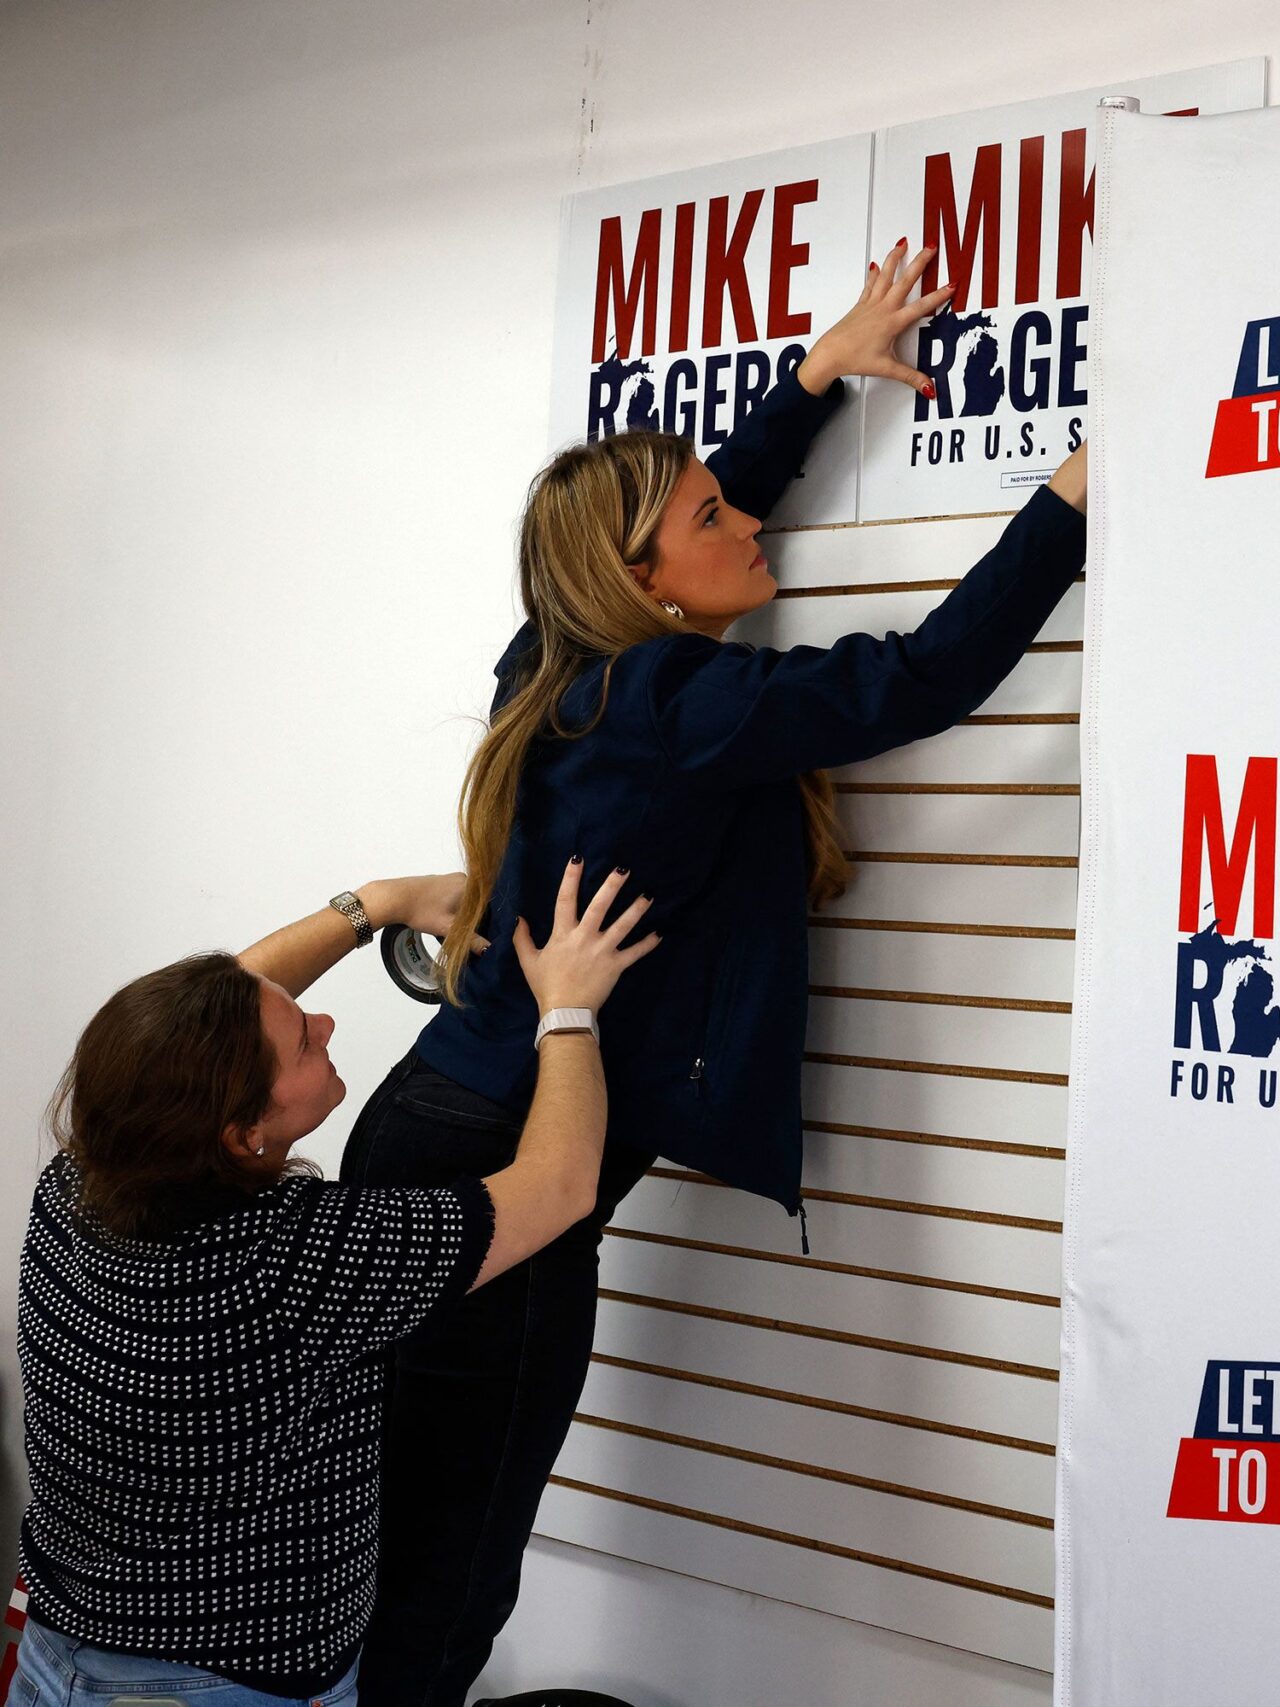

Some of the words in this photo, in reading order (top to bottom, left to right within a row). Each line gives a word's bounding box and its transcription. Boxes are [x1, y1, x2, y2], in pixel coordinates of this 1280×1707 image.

[920, 128, 1096, 313] MIK
[591, 179, 818, 363] MIKE
[910, 428, 965, 467] FOR
[984, 421, 1047, 461] U.S.
[1170, 1060, 1235, 1104] FOR
[1211, 1447, 1268, 1515] TO
